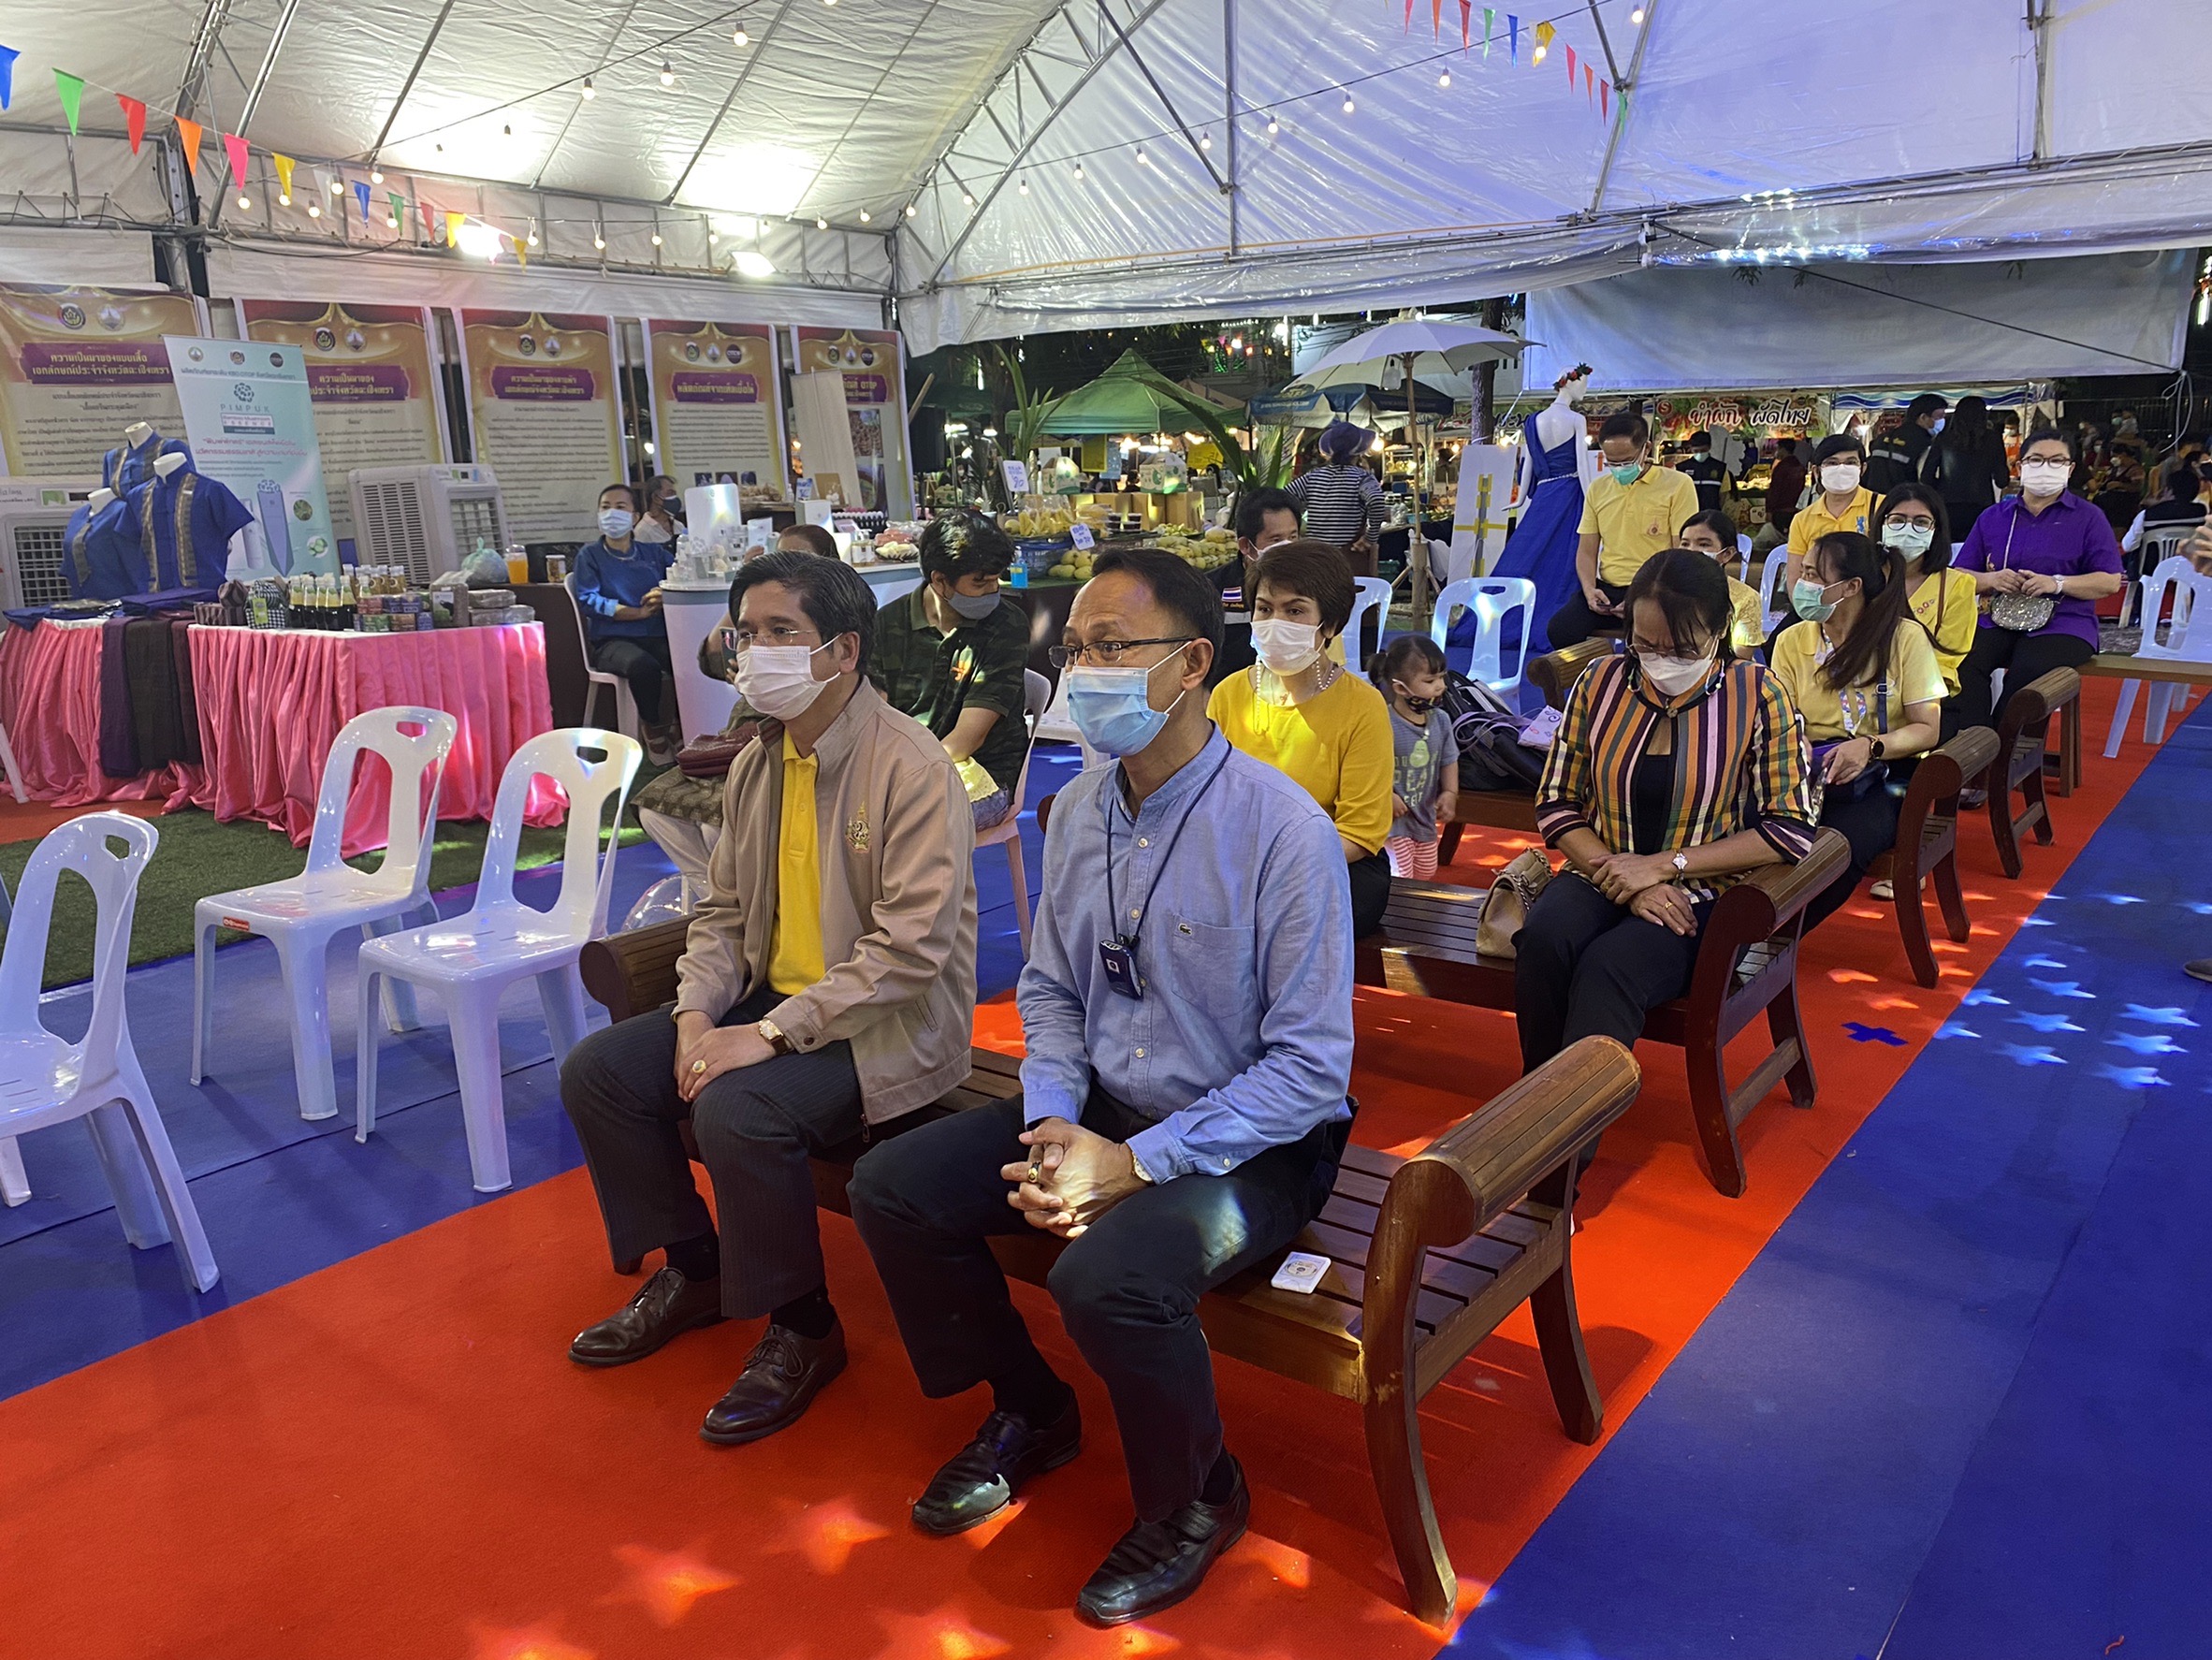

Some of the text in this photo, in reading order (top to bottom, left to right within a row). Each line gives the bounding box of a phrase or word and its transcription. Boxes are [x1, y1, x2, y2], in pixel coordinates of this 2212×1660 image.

[51, 350, 148, 362] ความเป็นมาของแบบเสื้อ
[32, 364, 170, 376] เอกลักษณ์ประจำจังหวัดฉะเชิงเทรา
[220, 404, 269, 413] PIMPUK
[1689, 398, 1811, 430] ยำผัก ผัดไทย
